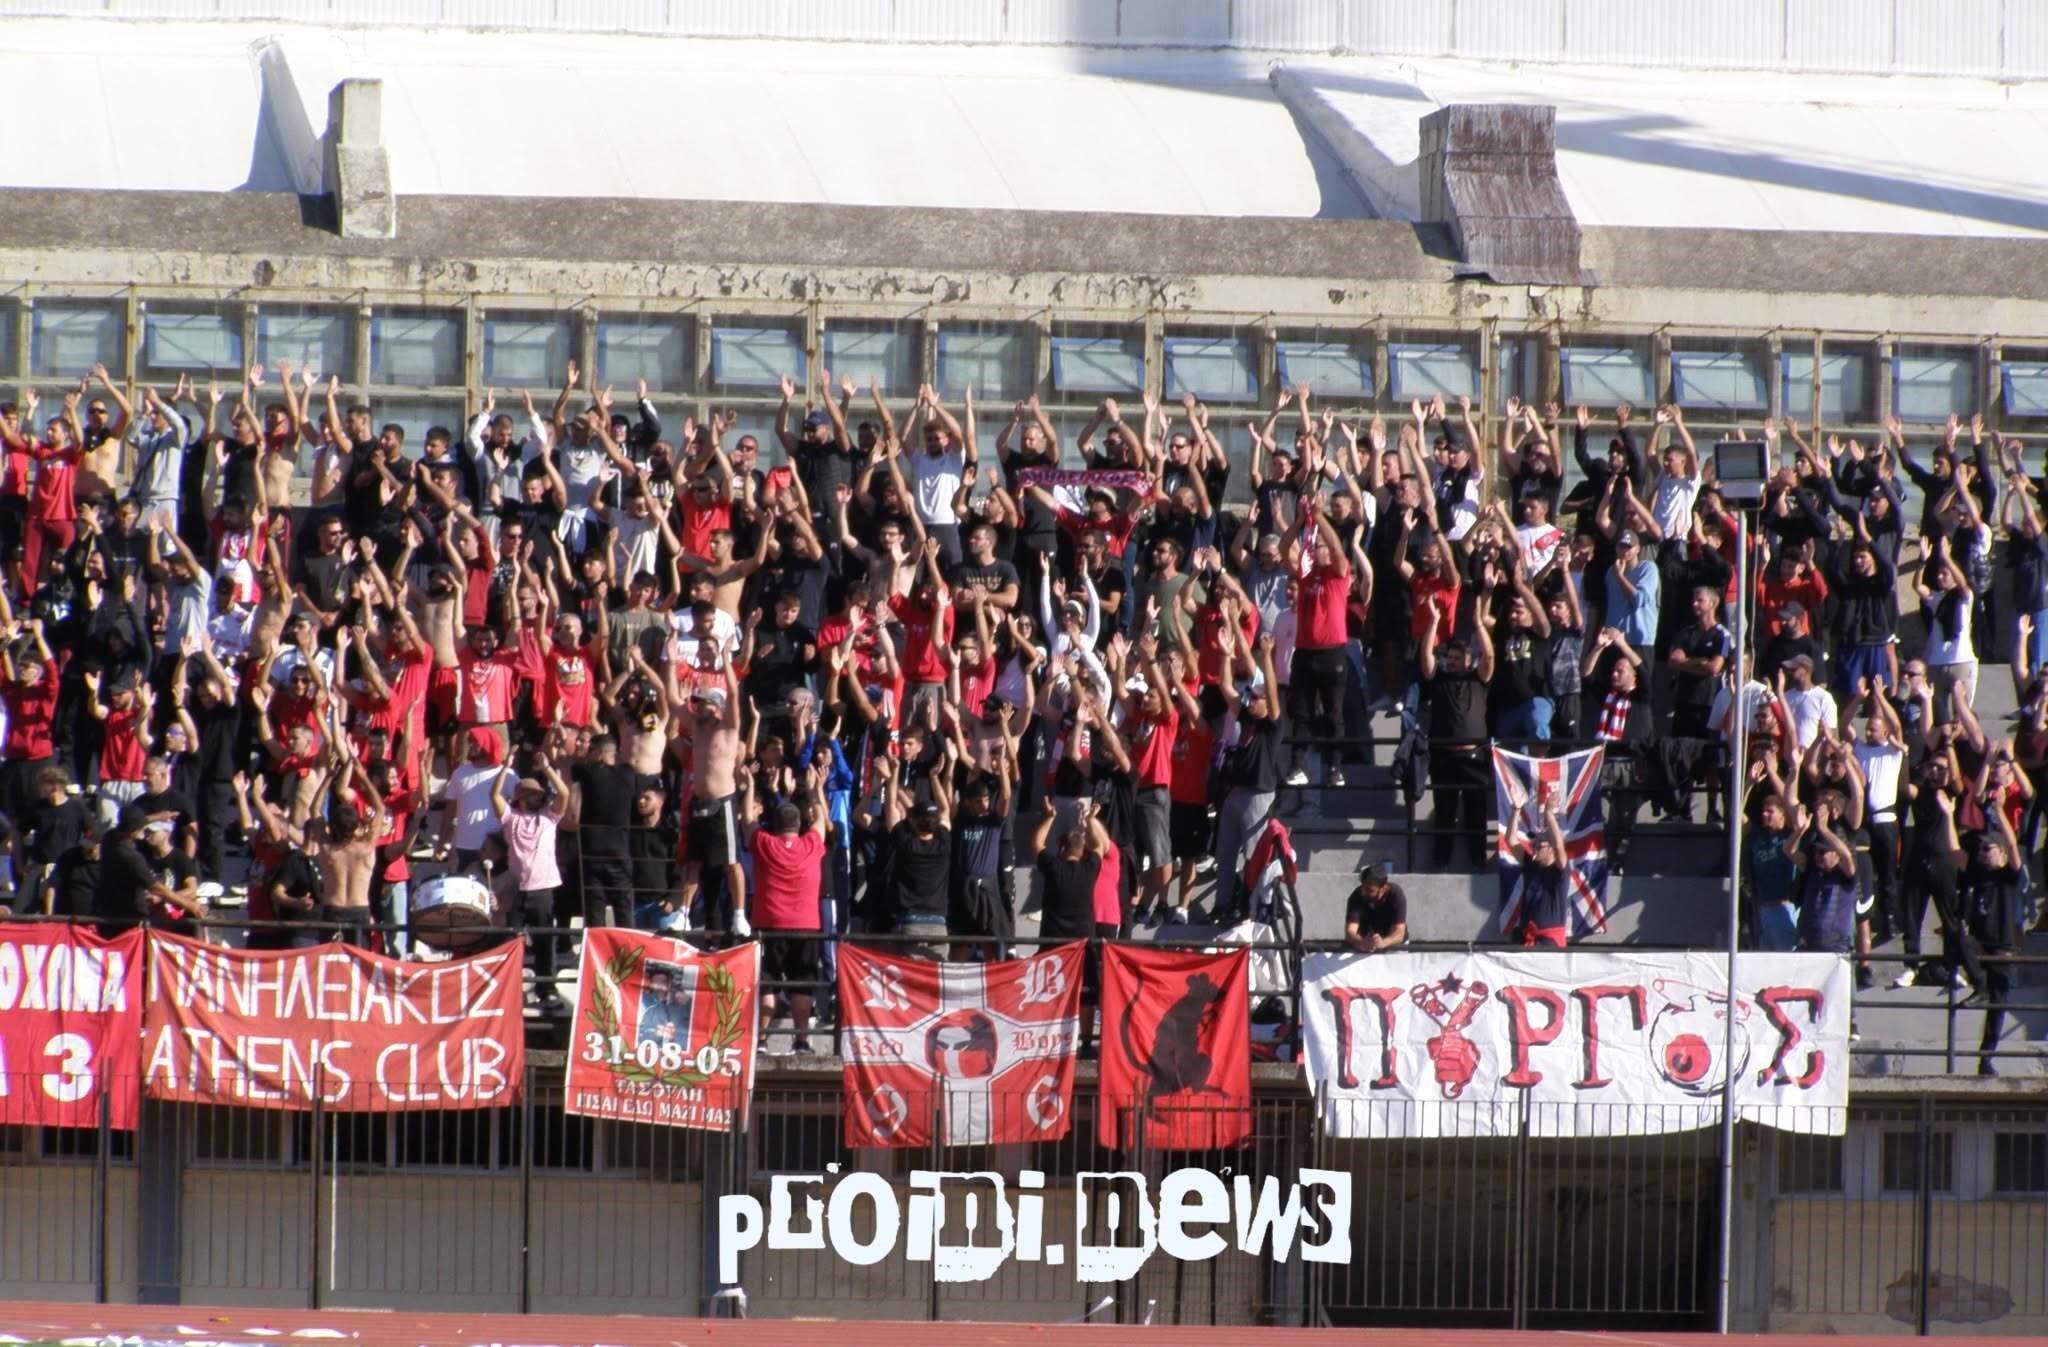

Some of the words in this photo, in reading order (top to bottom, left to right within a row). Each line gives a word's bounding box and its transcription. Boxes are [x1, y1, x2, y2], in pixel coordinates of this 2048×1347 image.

[149, 938, 508, 1025] ΠΑΝΗΛΕΙΑΚΟΣ
[42, 1032, 94, 1102] 3
[145, 1024, 352, 1103] ATHENS
[375, 1036, 508, 1103] CLUB
[581, 1031, 743, 1078] 31-08-05
[1011, 1030, 1074, 1053] Boys
